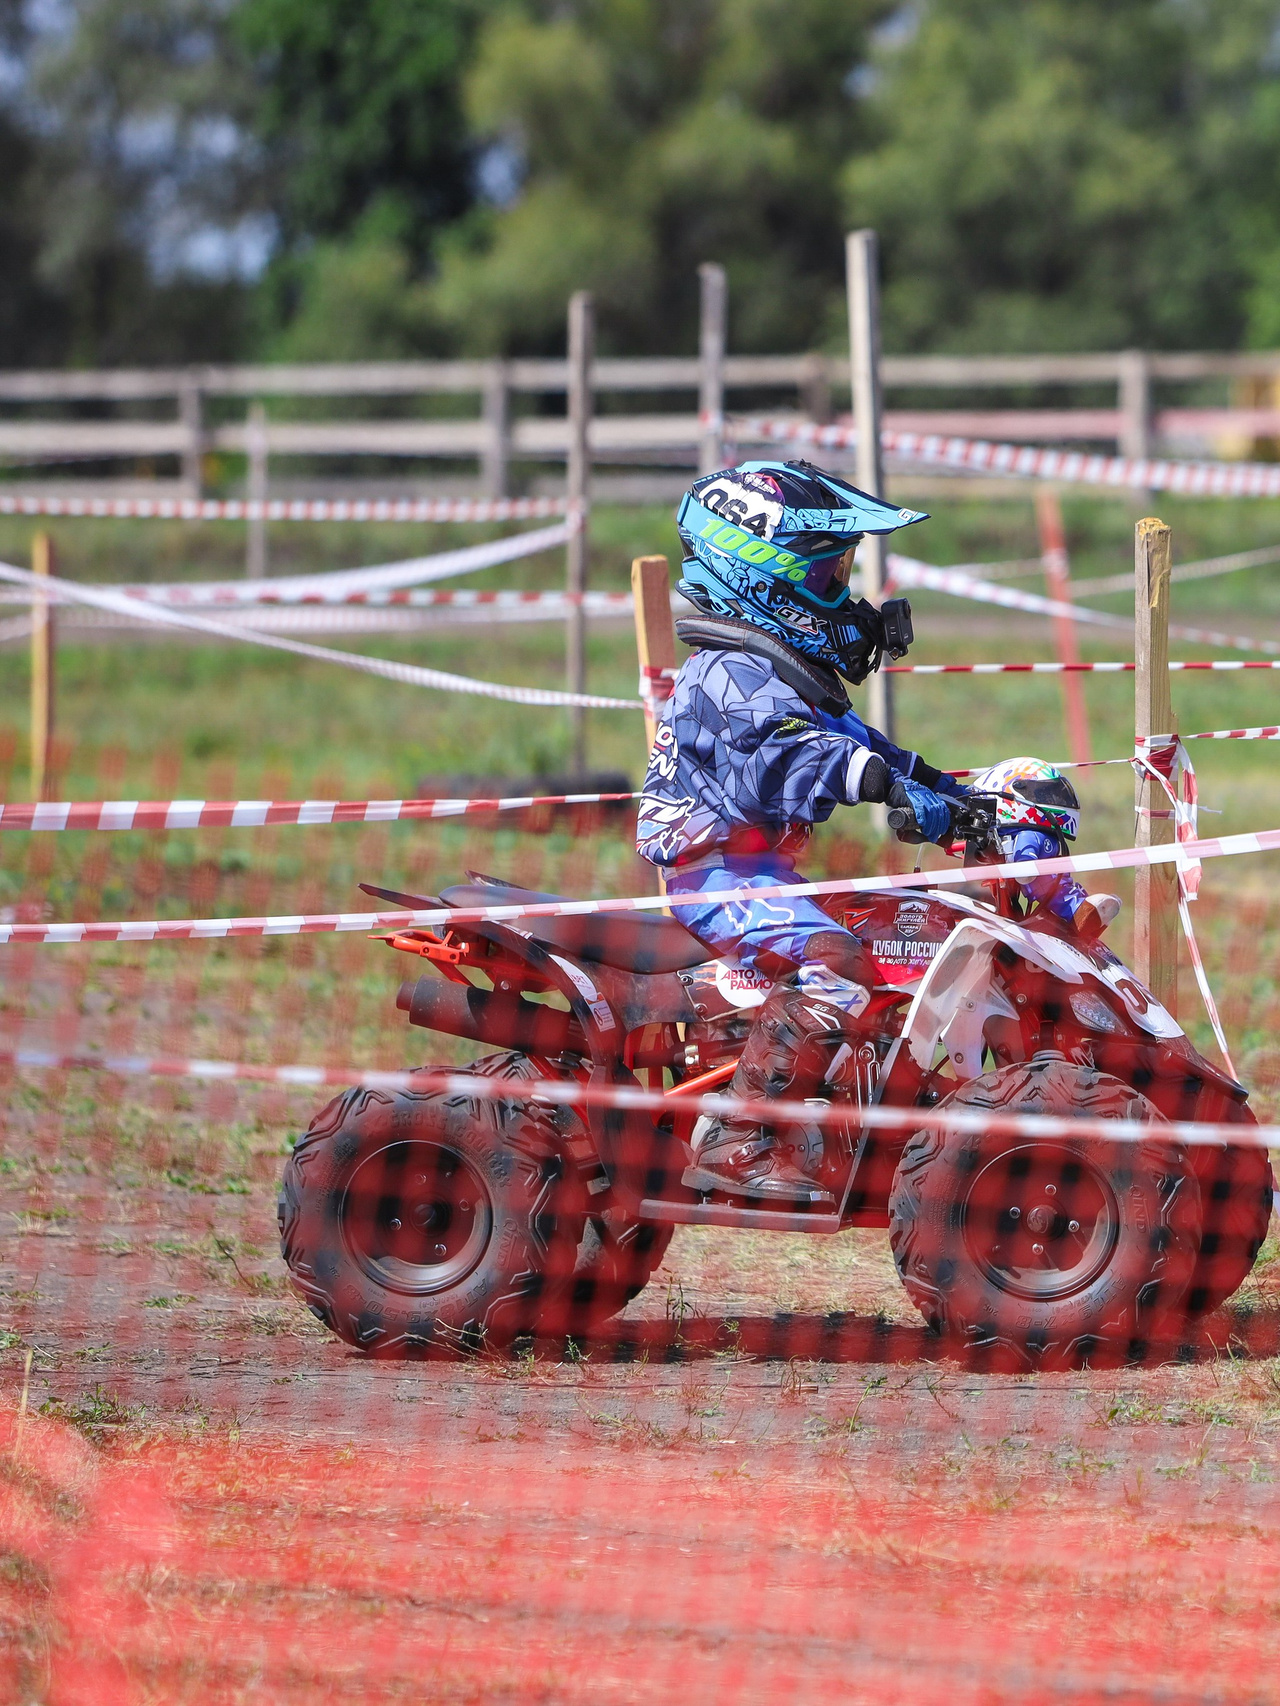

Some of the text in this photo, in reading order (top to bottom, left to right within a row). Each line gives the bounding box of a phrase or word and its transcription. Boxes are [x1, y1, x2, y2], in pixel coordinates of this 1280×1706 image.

[698, 518, 811, 582] 100%
[776, 606, 828, 634] GTX
[872, 940, 903, 956] КУБОК
[722, 969, 755, 980] АВТО
[730, 979, 773, 990] РАДИО
